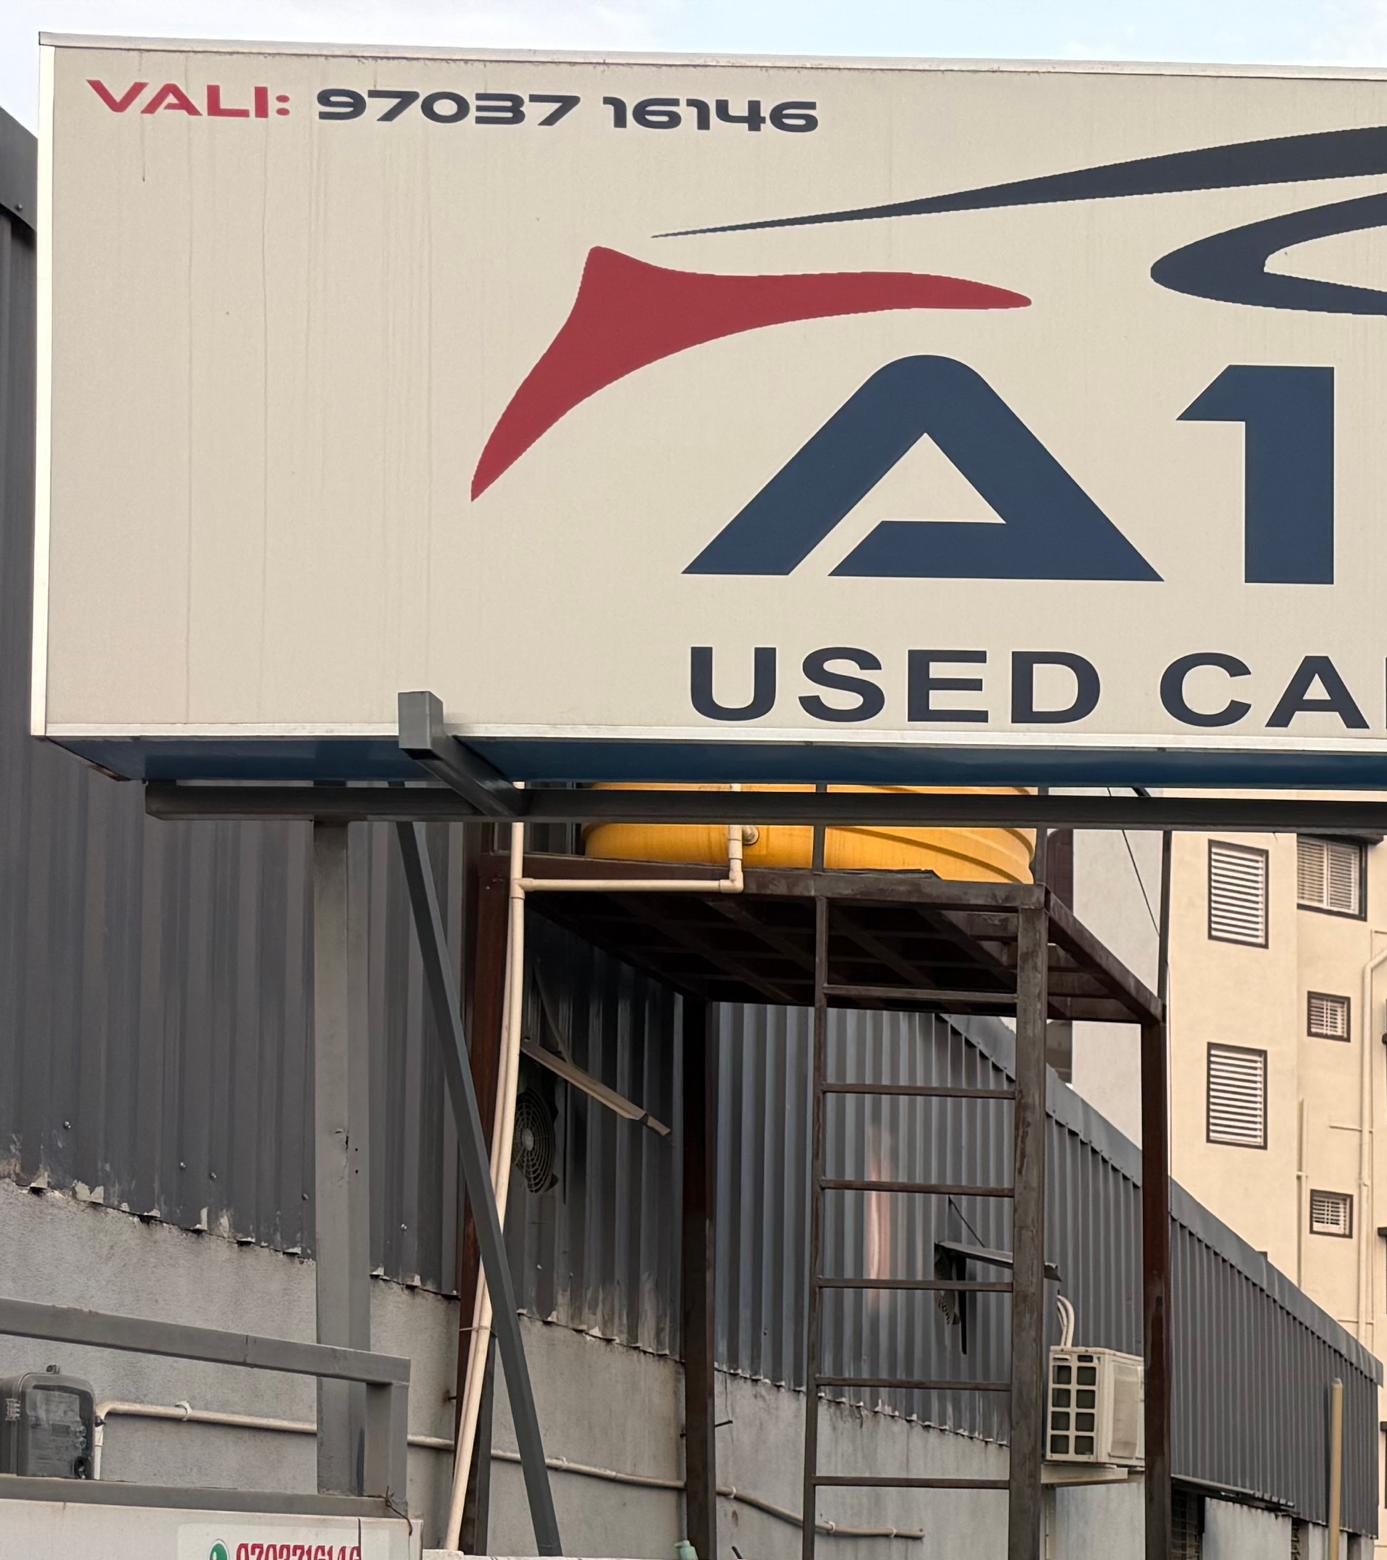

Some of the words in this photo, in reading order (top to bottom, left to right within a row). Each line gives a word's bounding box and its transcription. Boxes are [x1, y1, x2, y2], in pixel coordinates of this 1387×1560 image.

[86, 79, 290, 119] VALI:
[316, 88, 581, 127] 97037
[602, 96, 819, 133] 16146
[680, 353, 1335, 585] A1
[690, 646, 1101, 724] USED
